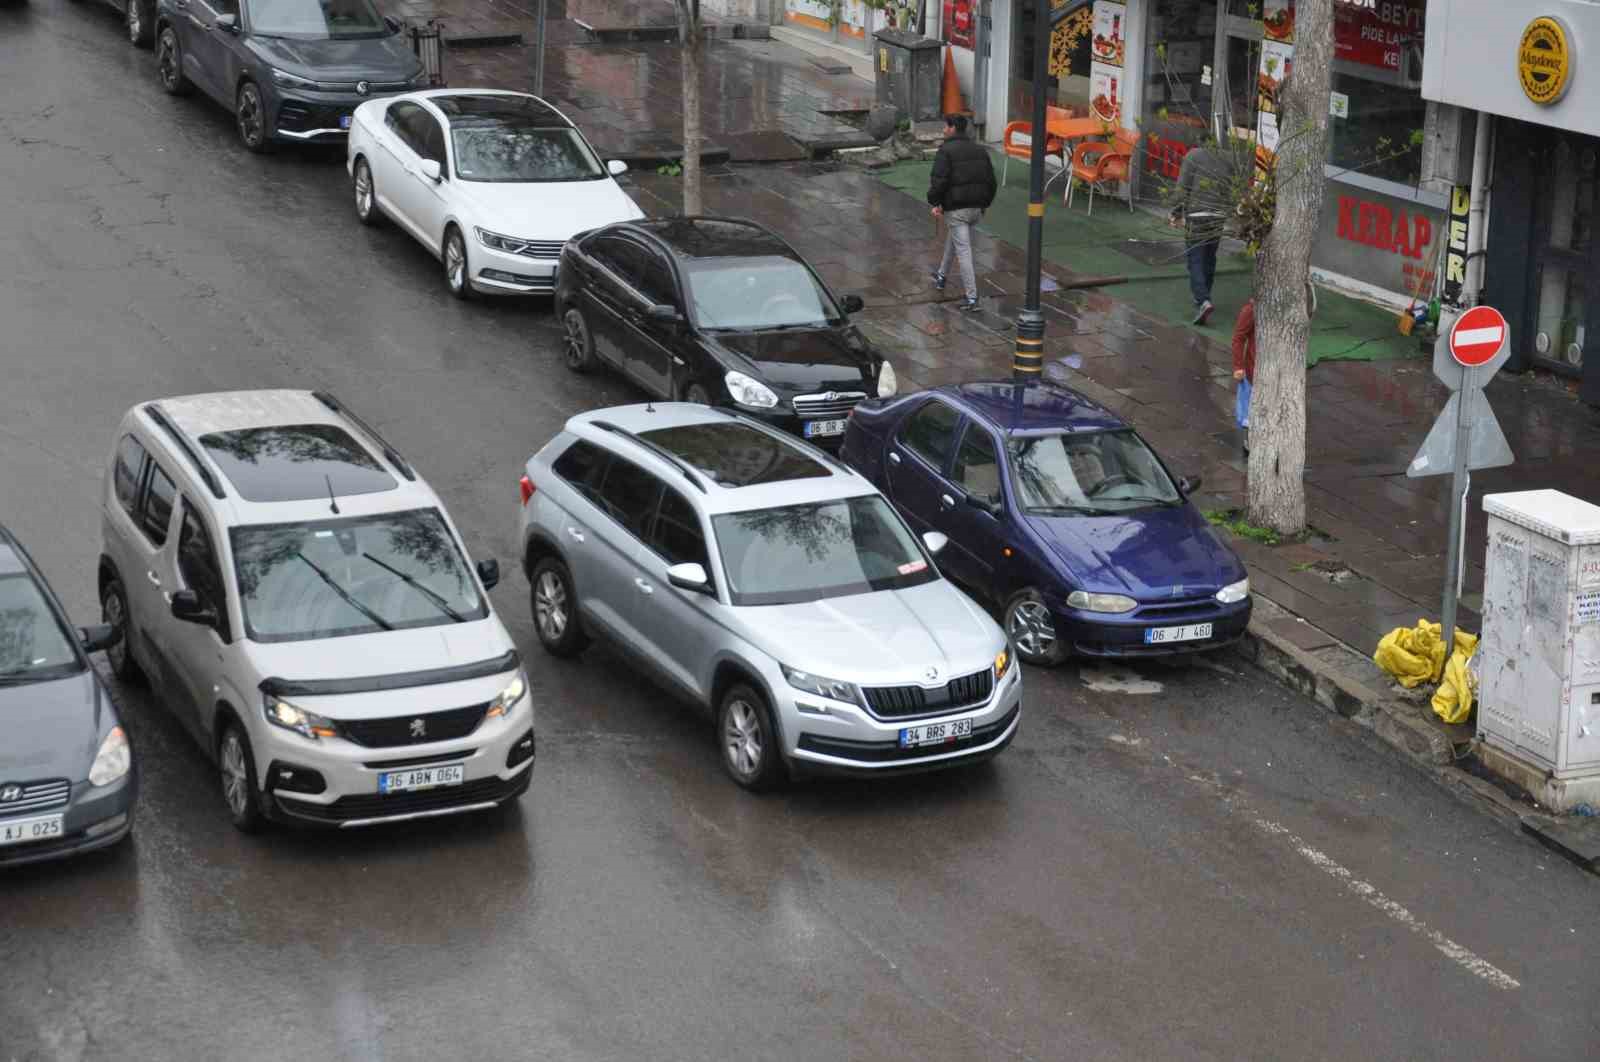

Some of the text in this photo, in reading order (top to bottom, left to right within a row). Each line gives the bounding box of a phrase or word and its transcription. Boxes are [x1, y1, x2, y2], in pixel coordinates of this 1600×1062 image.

[1152, 624, 1211, 641] 06 JT 460
[908, 720, 970, 742] 34 BRS 283
[408, 770, 432, 785] ABN
[437, 766, 460, 782] 064
[5, 820, 59, 841] AJ 025
